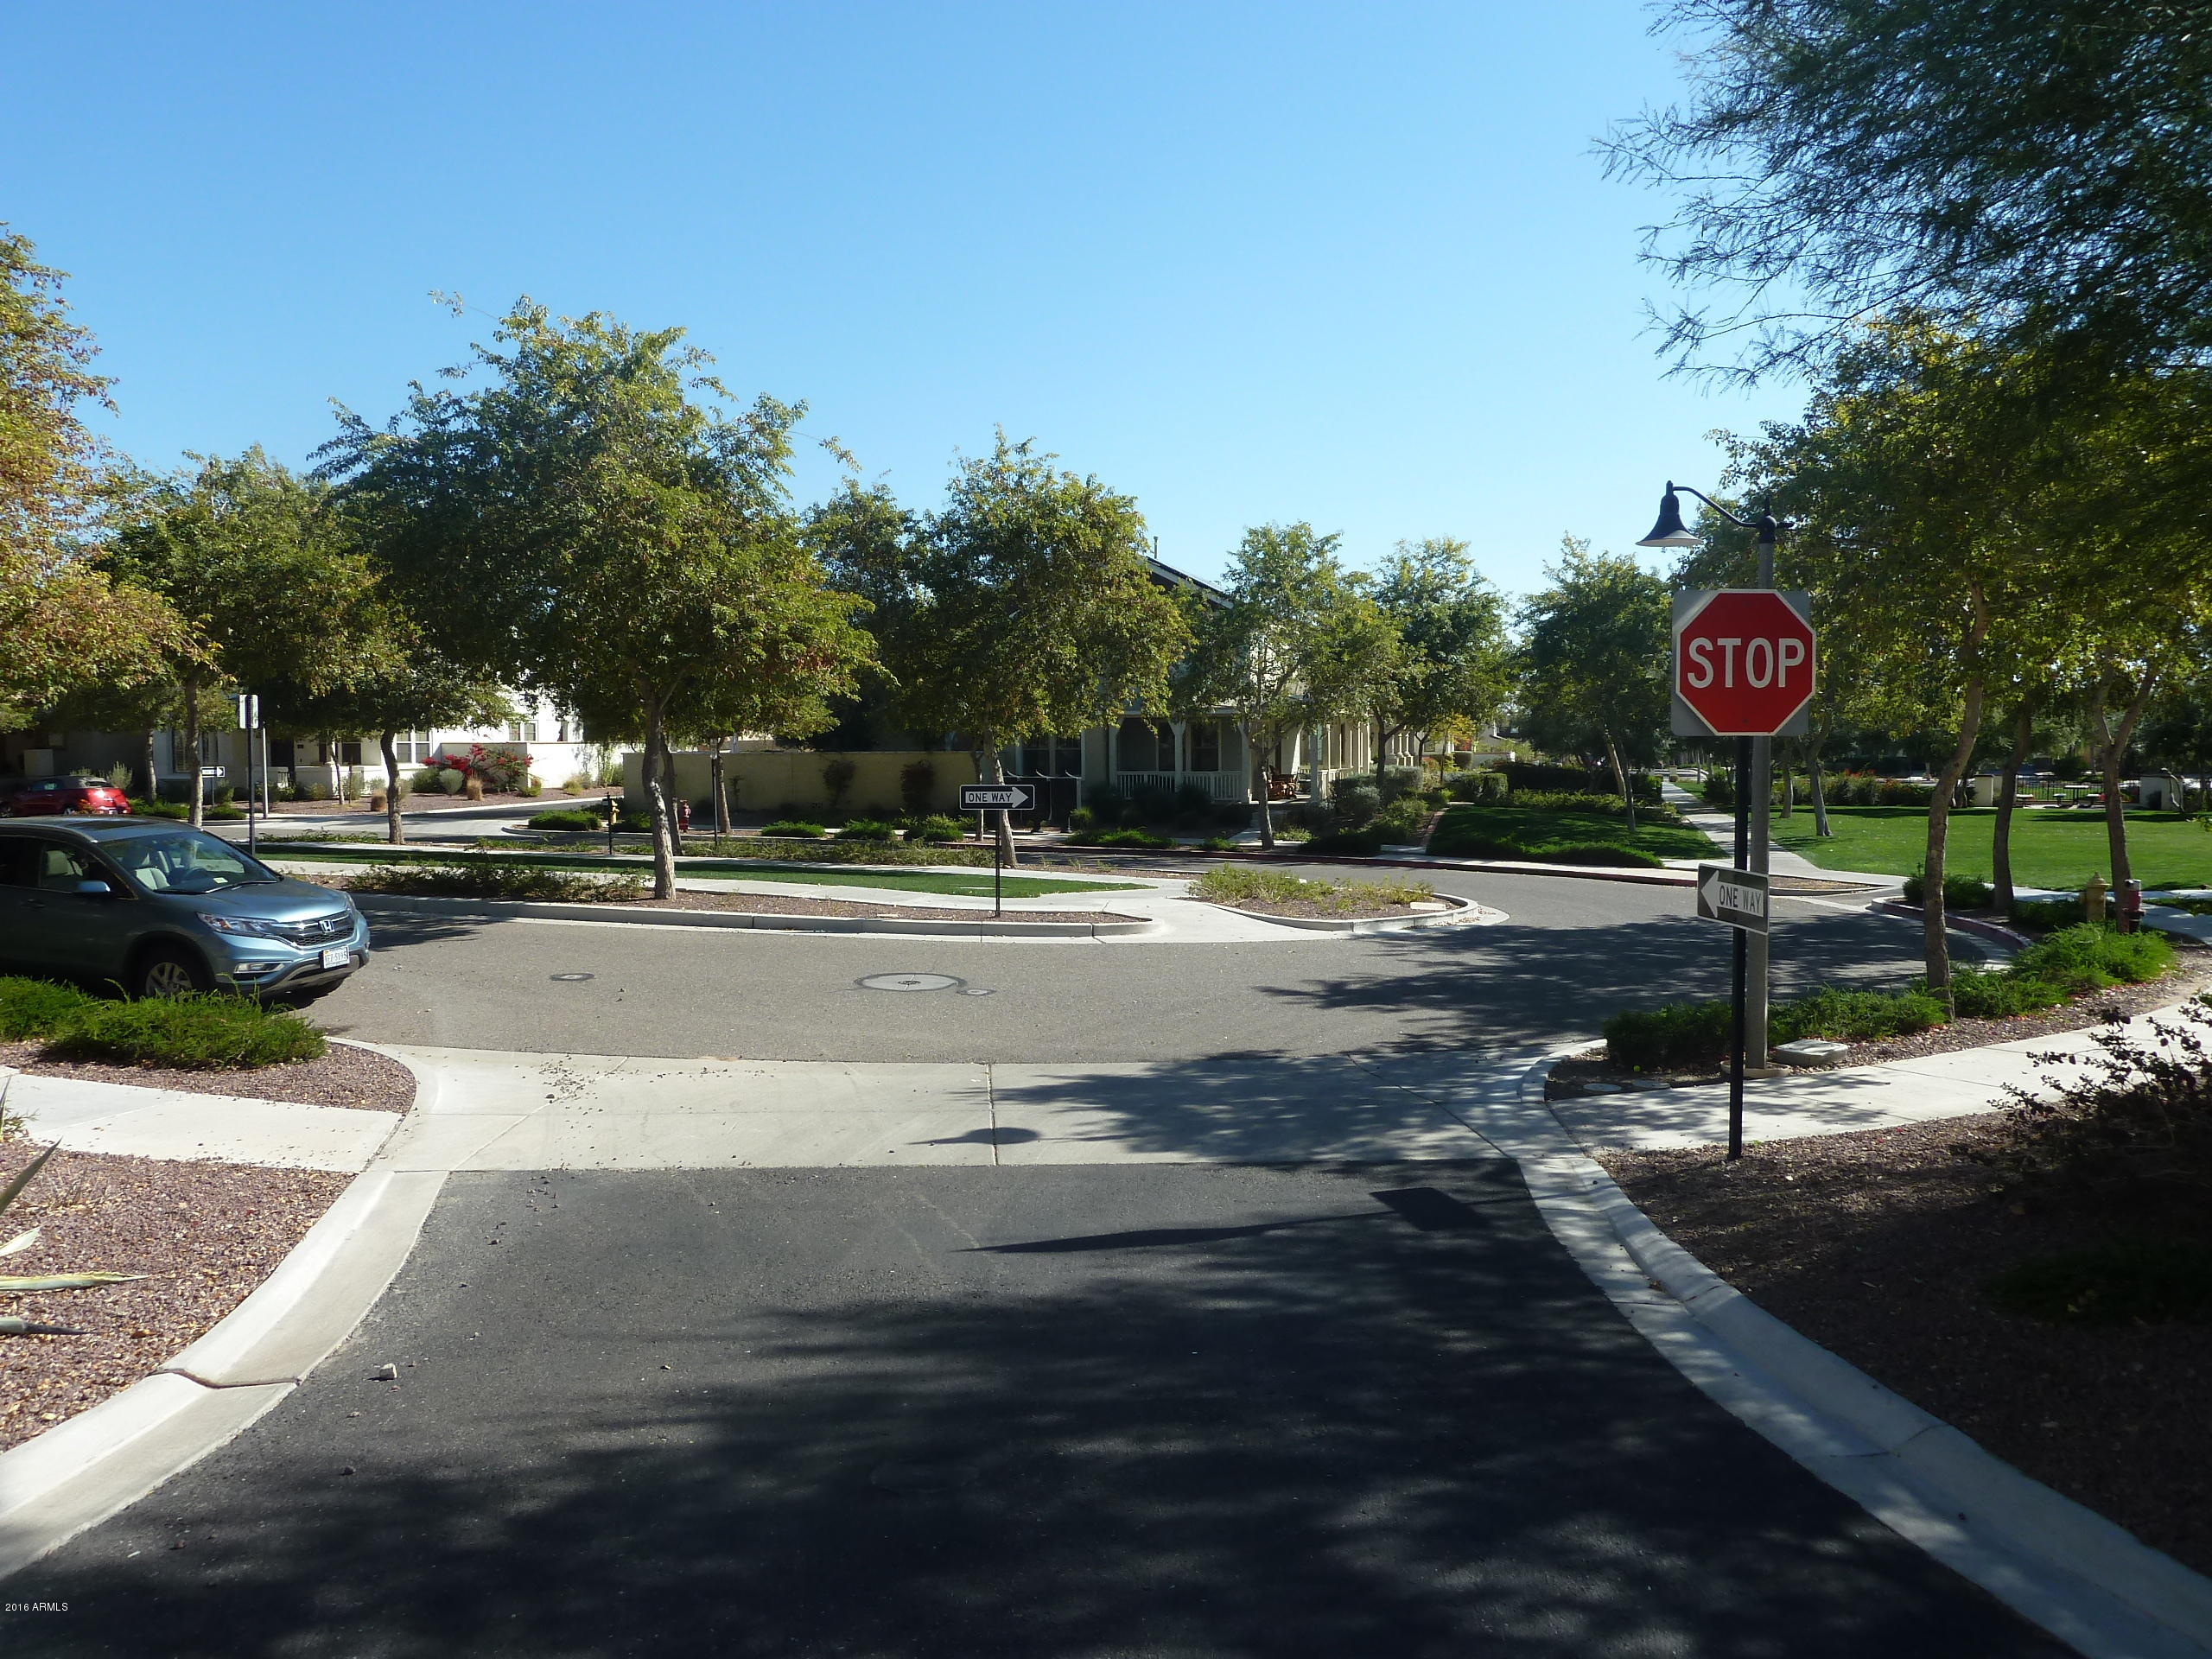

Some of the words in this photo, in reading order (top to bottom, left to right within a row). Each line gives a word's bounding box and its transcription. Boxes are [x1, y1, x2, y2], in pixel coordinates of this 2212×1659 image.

[1687, 637, 1805, 689] STOP
[968, 792, 988, 803] ONE
[991, 792, 1012, 803] WAY
[1719, 885, 1738, 908] ONE
[1742, 889, 1762, 913] WAY
